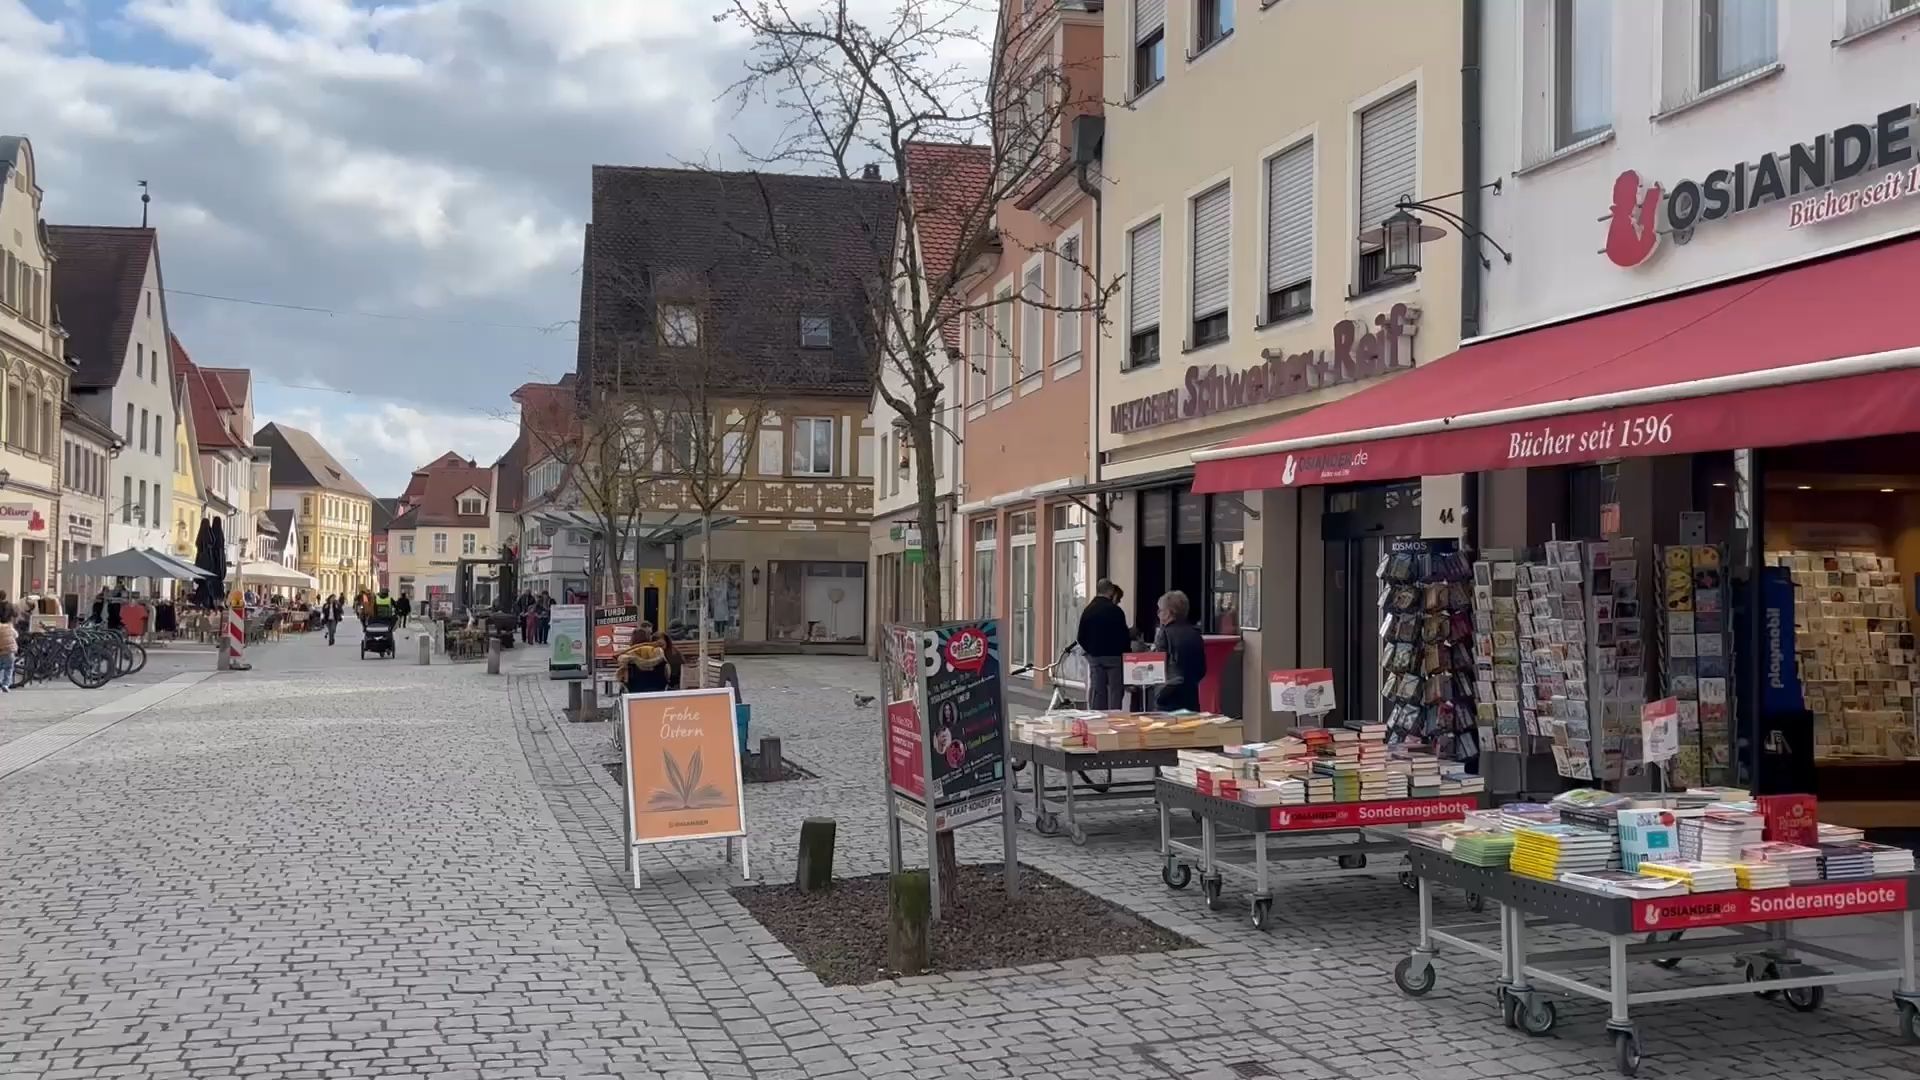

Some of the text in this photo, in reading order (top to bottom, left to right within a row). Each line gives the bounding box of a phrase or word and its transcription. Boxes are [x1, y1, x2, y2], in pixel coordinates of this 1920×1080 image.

[1668, 104, 1920, 230] OSIANDE
[1789, 165, 1920, 229] Bücher seit 1
[1111, 388, 1179, 434] METZGEREI
[1507, 413, 1673, 459] Bücher seit 1596
[1439, 507, 1454, 525] 44
[1766, 608, 1784, 689] playmobil
[660, 723, 704, 739] Ostern
[662, 706, 701, 724] Frohe
[1358, 801, 1470, 820] Sonderangebote
[1661, 887, 1896, 919] OSIANDER.de Sonderangebote
